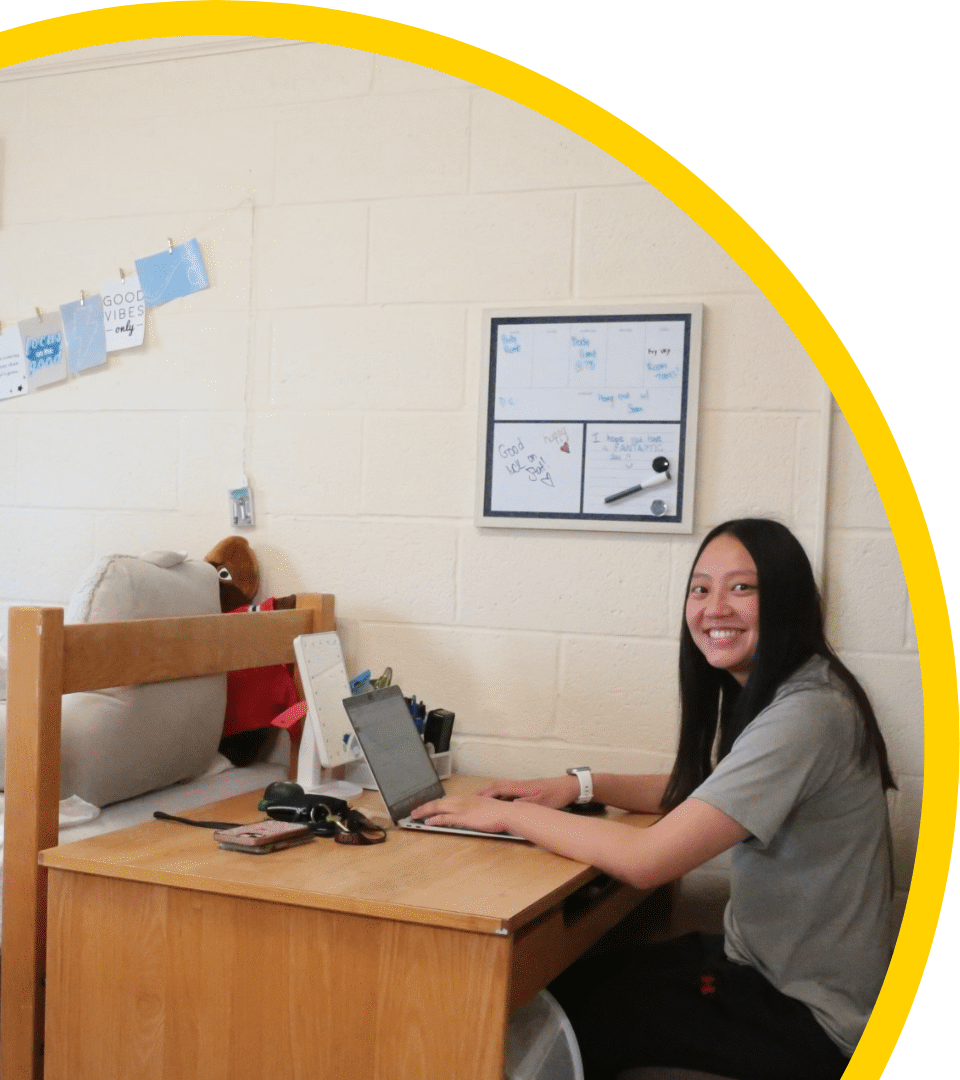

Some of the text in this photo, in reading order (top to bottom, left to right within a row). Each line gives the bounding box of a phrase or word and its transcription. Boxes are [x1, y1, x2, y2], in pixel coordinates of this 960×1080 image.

[103, 290, 145, 307] GOOD
[104, 305, 145, 321] VIBES
[115, 319, 135, 337] only
[498, 436, 525, 459] Good
